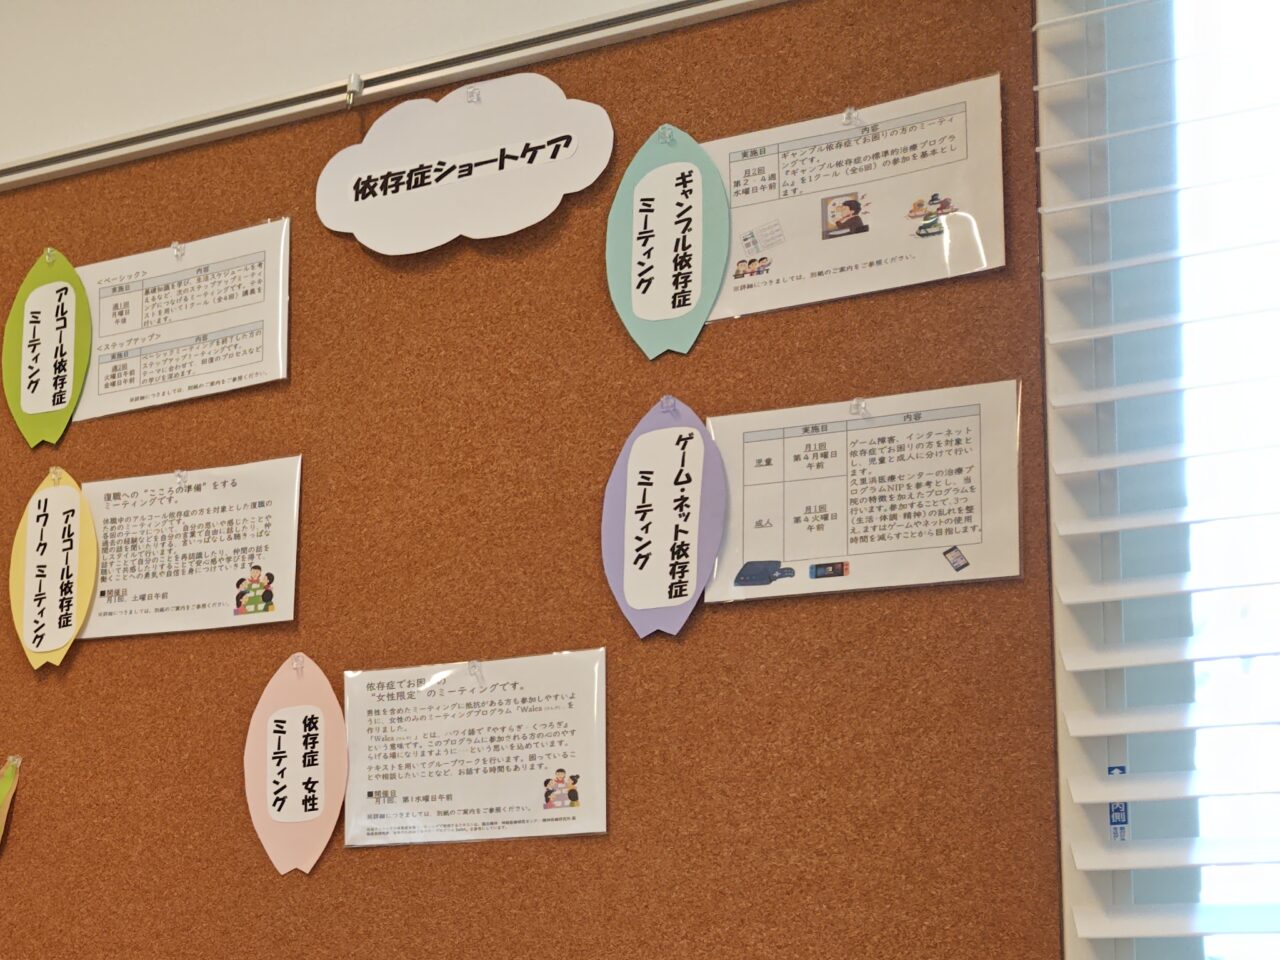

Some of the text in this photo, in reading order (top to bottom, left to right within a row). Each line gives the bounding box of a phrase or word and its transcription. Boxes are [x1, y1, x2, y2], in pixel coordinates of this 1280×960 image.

[780, 114, 954, 162] ギャンブル依存症でお困りの方のミーティ
[860, 123, 879, 135] 内容
[741, 146, 766, 159] 実施日
[781, 153, 821, 170] ングです。
[353, 135, 573, 202] 依存症ショートケア
[742, 165, 766, 179] 月2回
[733, 180, 776, 198] 水曜日午前
[781, 185, 804, 197] ます。
[635, 197, 655, 295] ミーティング
[671, 170, 694, 309] ギャンブル依存症
[195, 264, 209, 275] 内容
[111, 308, 129, 319] 月曜日
[51, 286, 69, 407] アルコール依存症
[194, 333, 208, 343] 内容
[26, 311, 41, 394] ミーティング
[902, 412, 922, 422] 内容
[800, 423, 828, 434] 実施日
[849, 425, 972, 448] ゲーム障害、インターネット
[803, 441, 827, 452] 月1回
[849, 435, 972, 458] 依存症でお困りの方を対象と
[754, 456, 773, 467] 児童
[805, 460, 824, 471] 午前
[850, 445, 972, 468] し、児童と成人に分けて行い
[849, 465, 974, 487] 久里浜医療センターの治療プ
[850, 466, 872, 476] ます。
[103, 493, 178, 512] ミーティングです。
[849, 484, 976, 506] 院の特徴を加えたプログラムを
[667, 432, 695, 600] ゲーム・ネット依存症
[803, 503, 827, 514] 月1回
[101, 516, 186, 533] ためのミーティングです。
[633, 470, 655, 571] ミーティング
[754, 518, 773, 528] 成人
[806, 522, 824, 533] 午前
[848, 522, 981, 544] 時間を減らすことから目指します。
[32, 497, 49, 648] リワーク ミーティング
[58, 508, 75, 629] アルコール依存症
[366, 723, 407, 734] 作りました。
[271, 719, 288, 813] ミーティング
[302, 715, 320, 813] 依存症 女性
[1112, 803, 1127, 823] 内側
